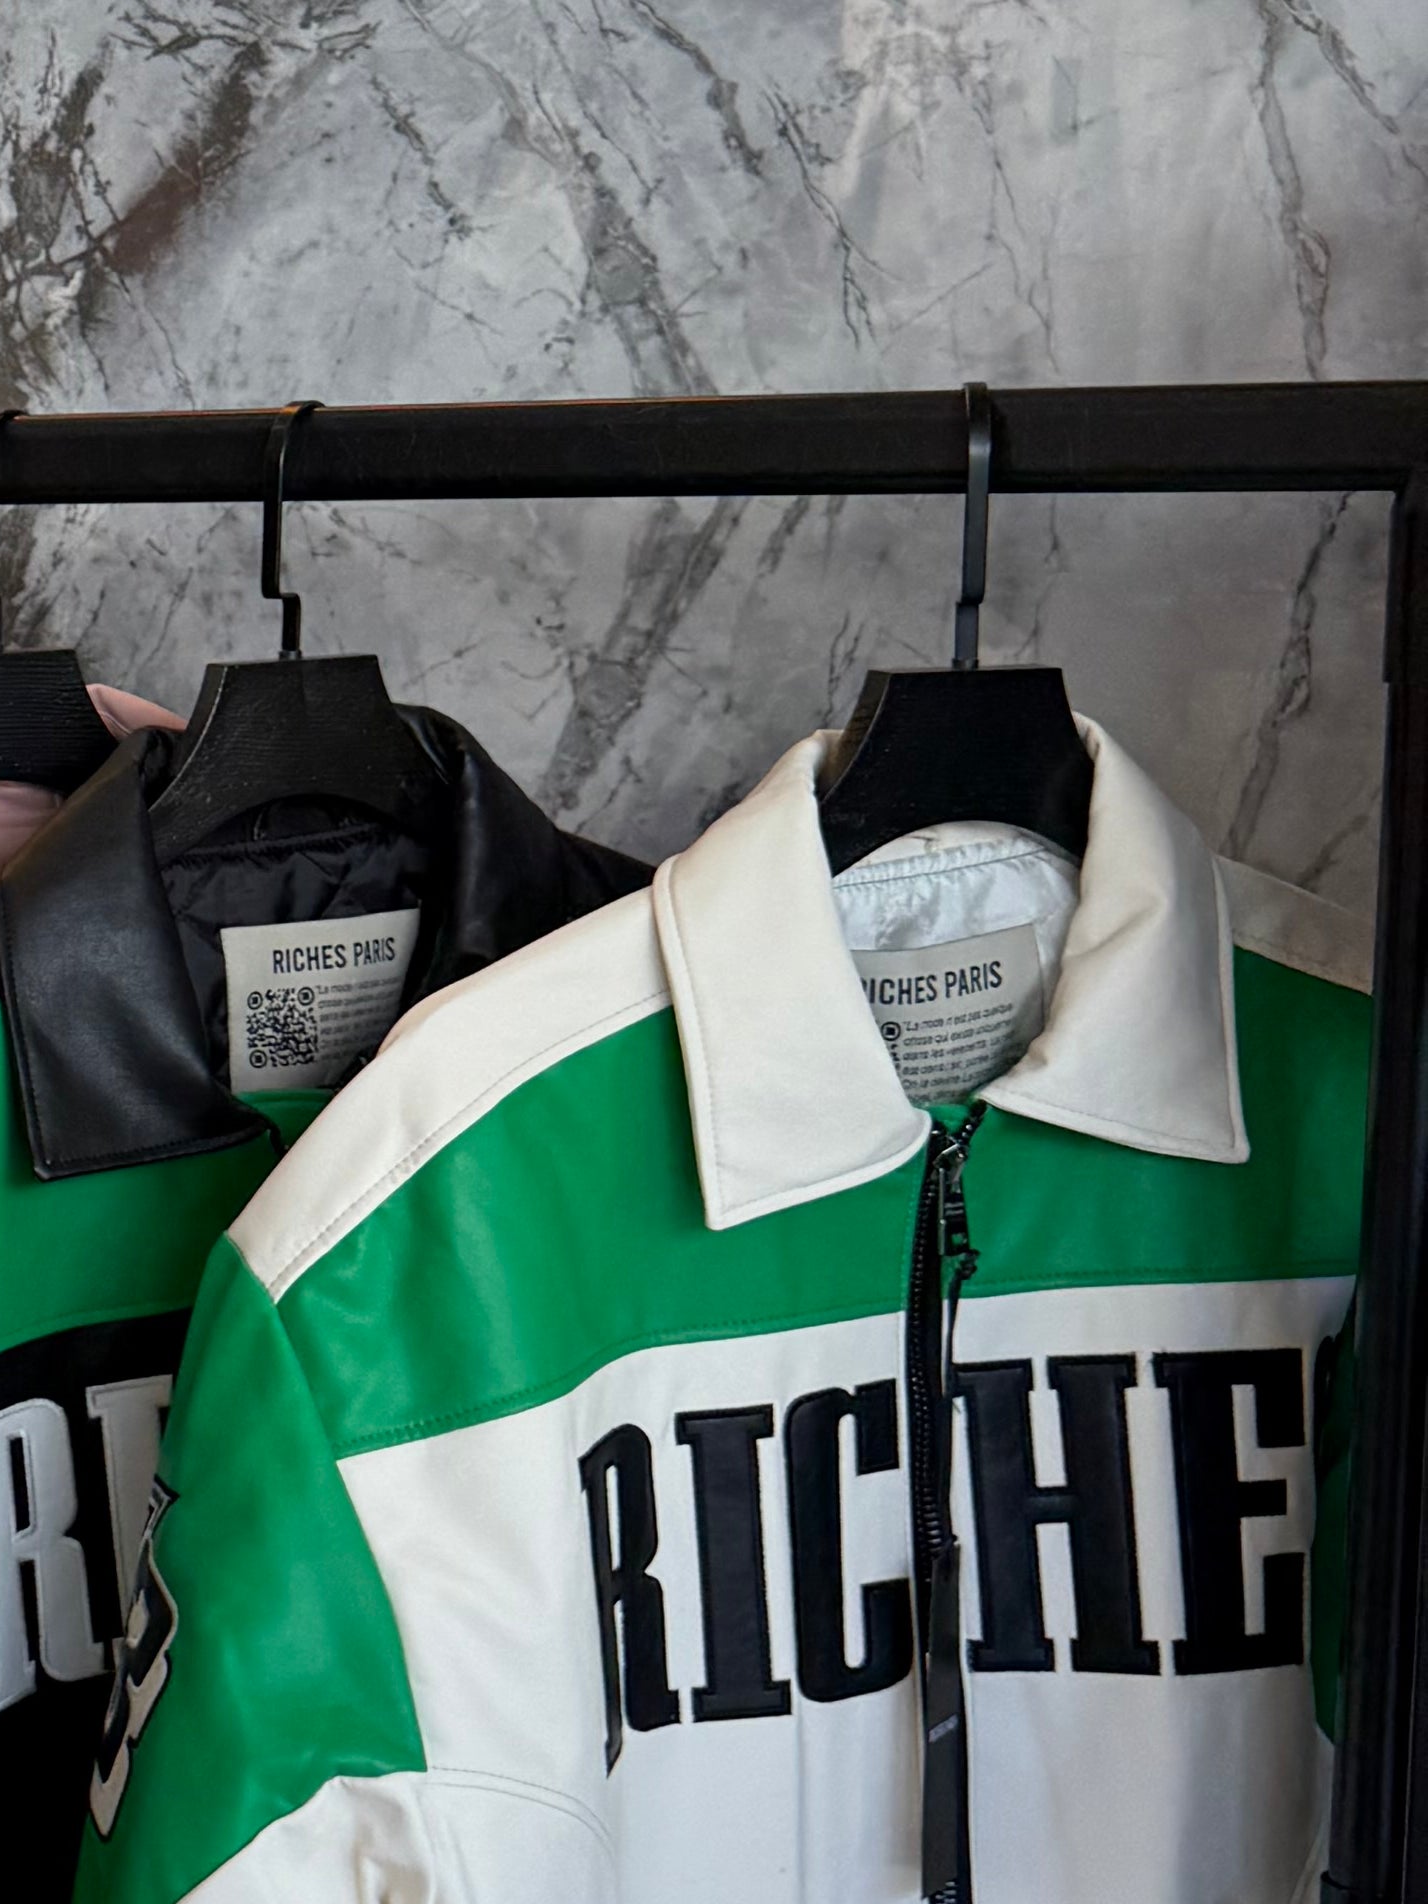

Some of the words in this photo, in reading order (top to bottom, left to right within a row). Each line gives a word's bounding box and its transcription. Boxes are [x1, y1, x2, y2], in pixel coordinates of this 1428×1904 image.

[272, 944, 347, 974] RICHES
[352, 937, 396, 967] PARIS
[945, 961, 1003, 999] PARIS
